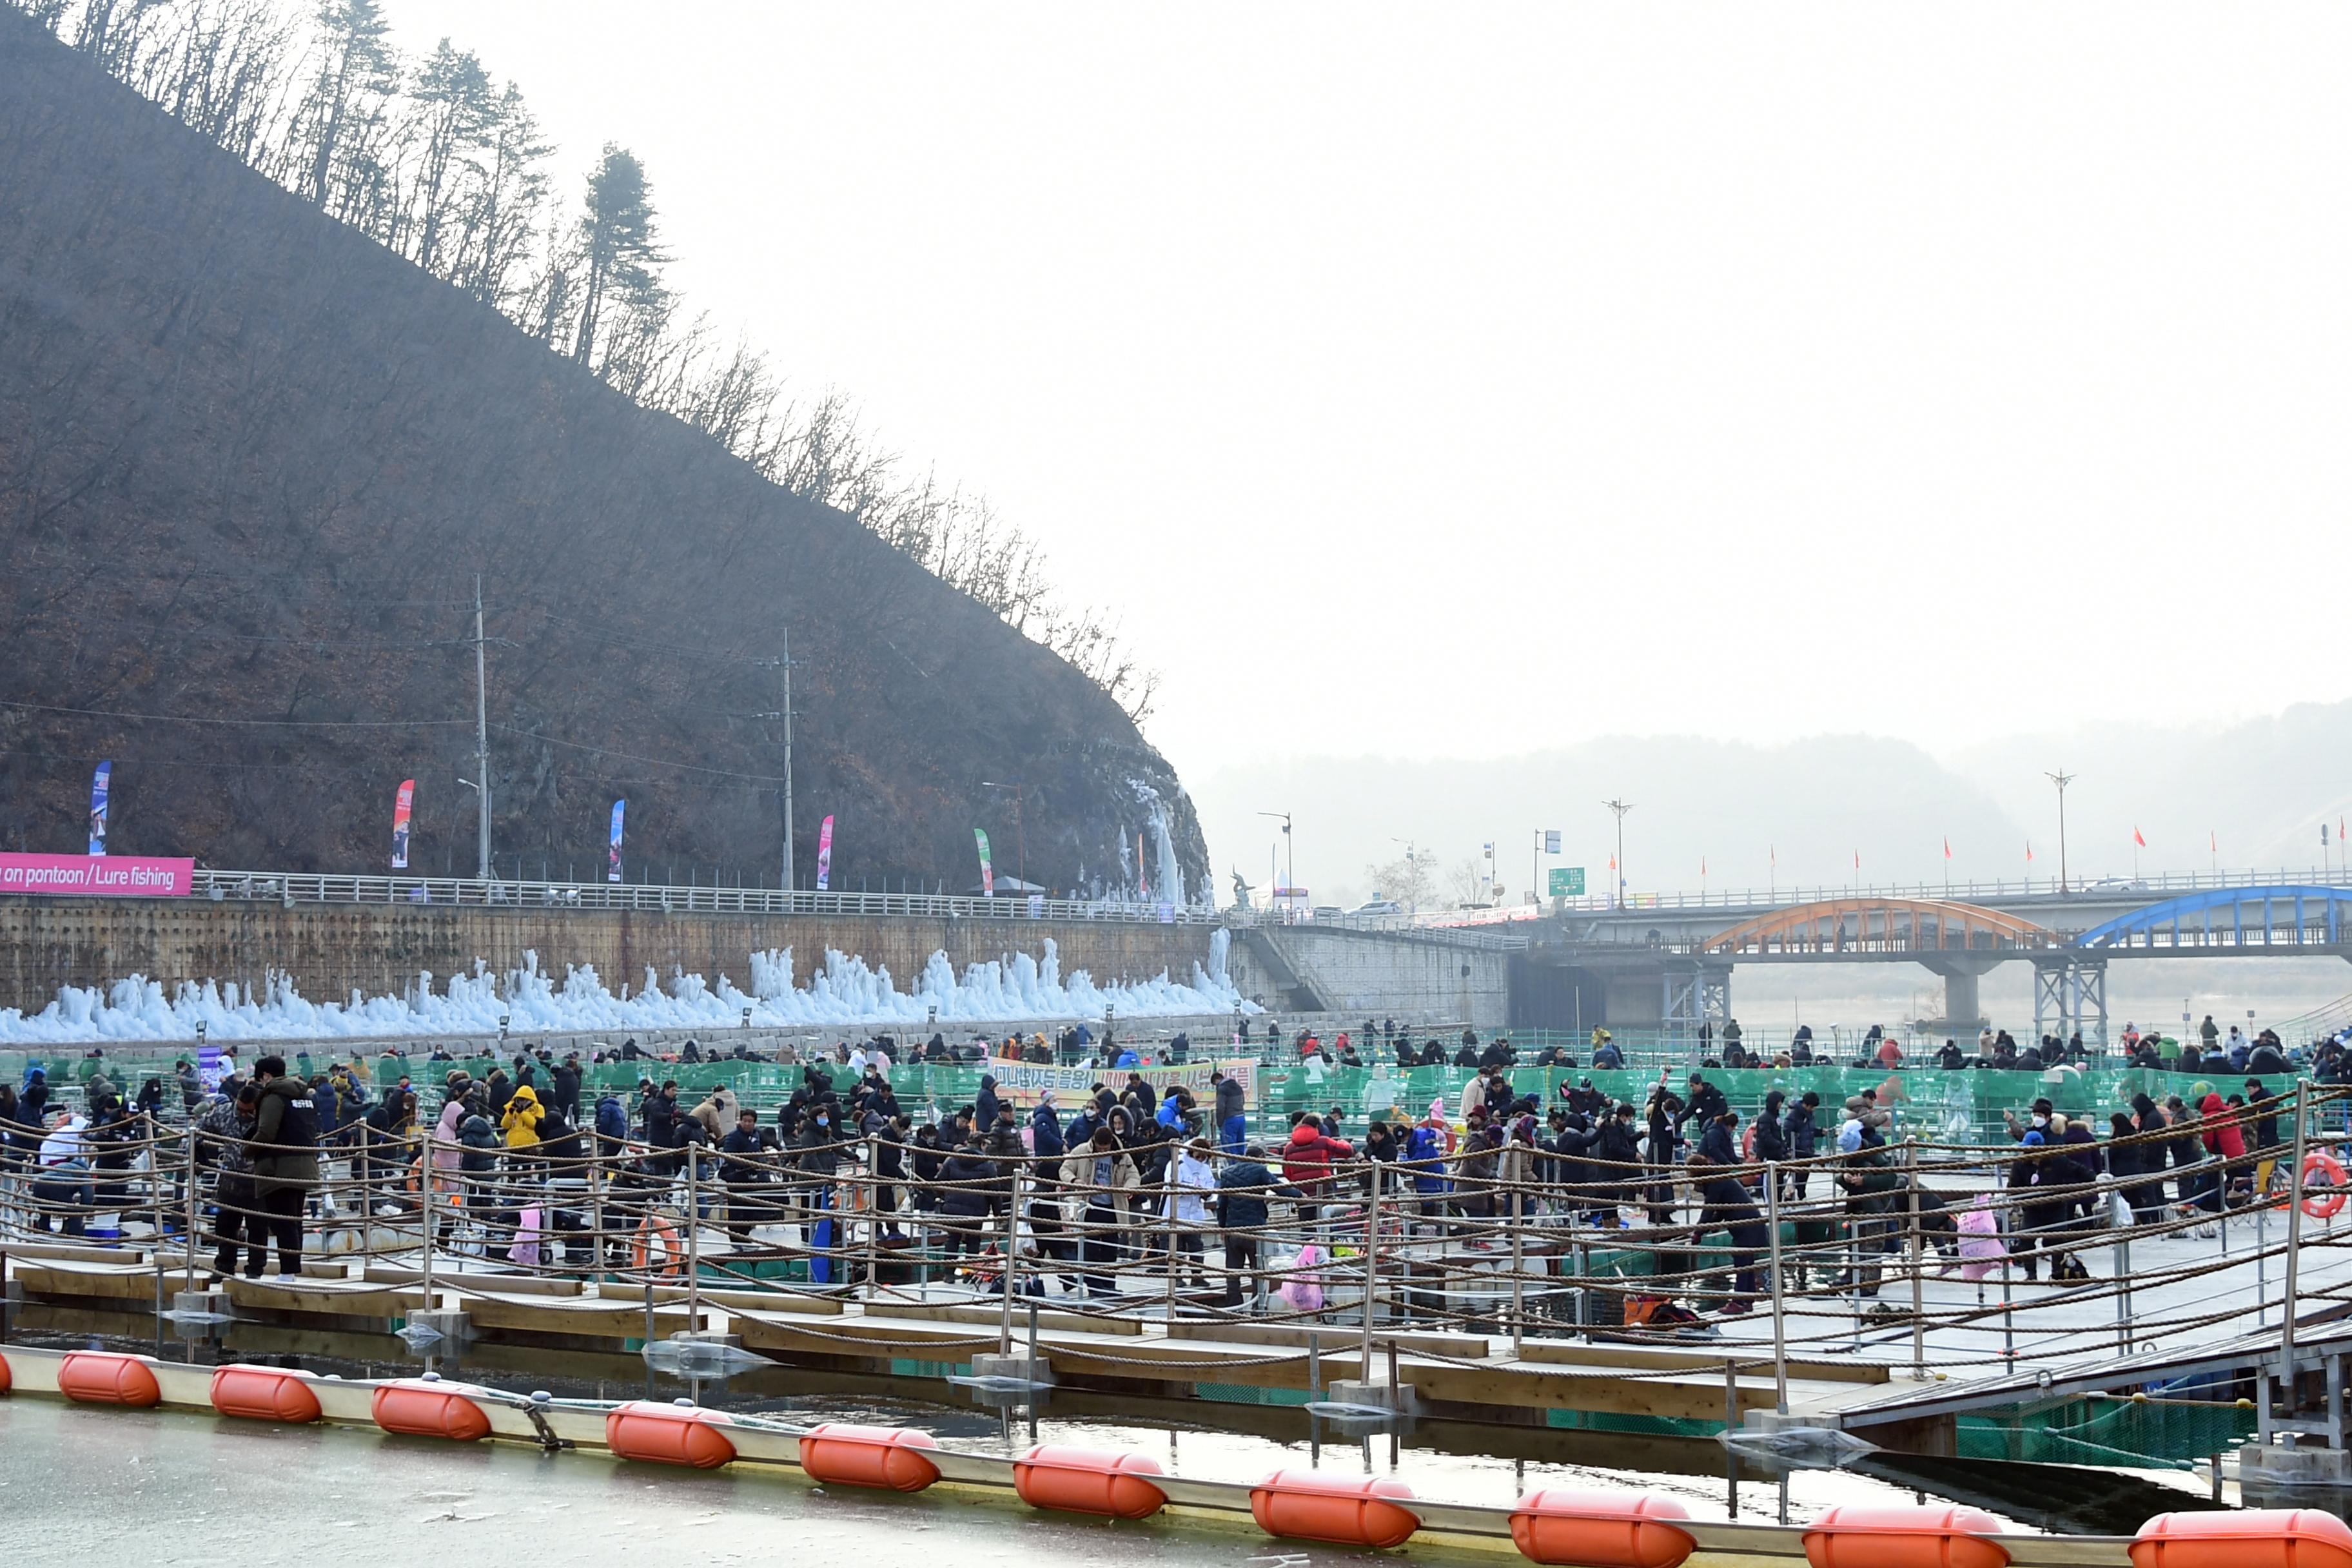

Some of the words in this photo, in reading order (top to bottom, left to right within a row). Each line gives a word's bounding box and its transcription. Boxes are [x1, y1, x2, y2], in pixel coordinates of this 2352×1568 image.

[5, 867, 23, 883] on
[26, 866, 84, 888] pontoon
[131, 867, 175, 891] fishing
